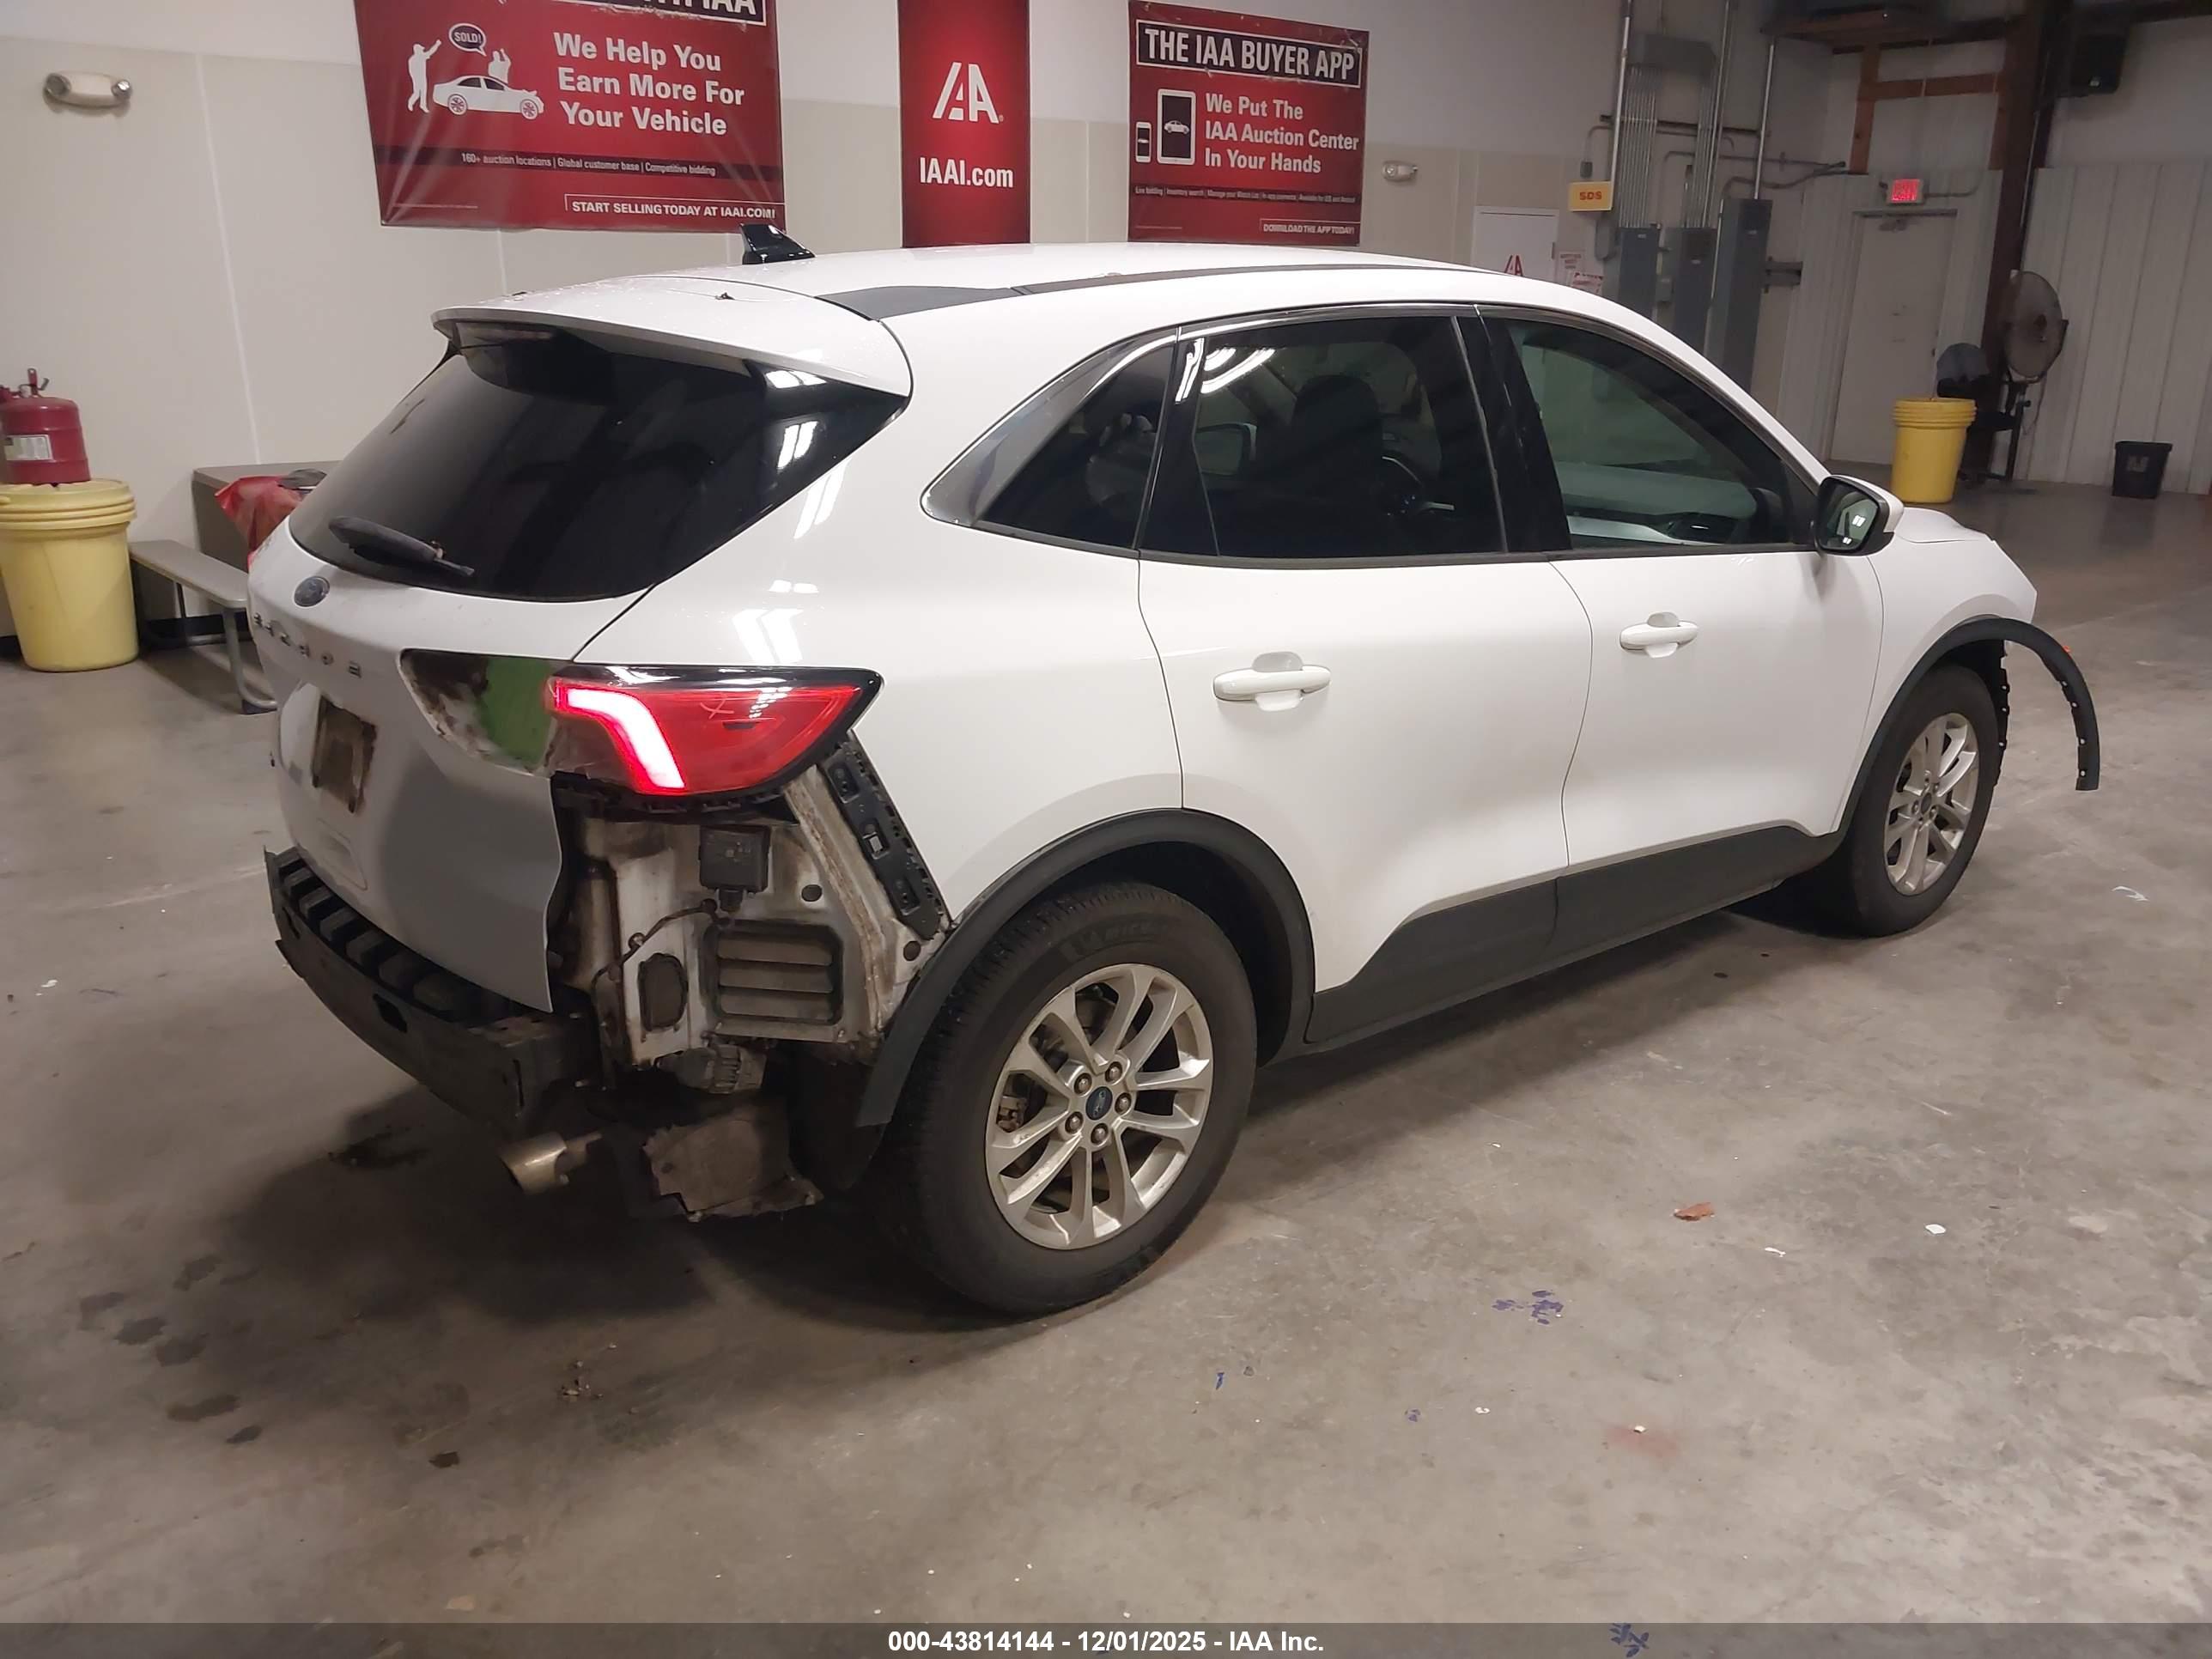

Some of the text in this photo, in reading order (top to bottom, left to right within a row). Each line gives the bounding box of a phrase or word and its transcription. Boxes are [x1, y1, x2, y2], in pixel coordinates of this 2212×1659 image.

[454, 32, 481, 44] SOLD!
[553, 32, 721, 72] We Help You
[1145, 29, 1355, 80] THE IAA BUYER APP
[558, 67, 744, 106] Earn More For
[559, 100, 727, 136] Your Vehicle
[1206, 92, 1304, 120] We Put The
[1205, 120, 1359, 150] IAA Auction Center
[483, 155, 514, 164] auction
[516, 155, 551, 167] locations
[557, 158, 582, 168] Global
[585, 161, 619, 170] customer
[621, 161, 639, 171] base
[920, 157, 1014, 188] IAAI.com
[1205, 147, 1322, 173] In Your Hands
[572, 201, 610, 213] START
[613, 203, 662, 215] SELLING
[663, 204, 701, 216] TODAY
[703, 206, 719, 216] AT
